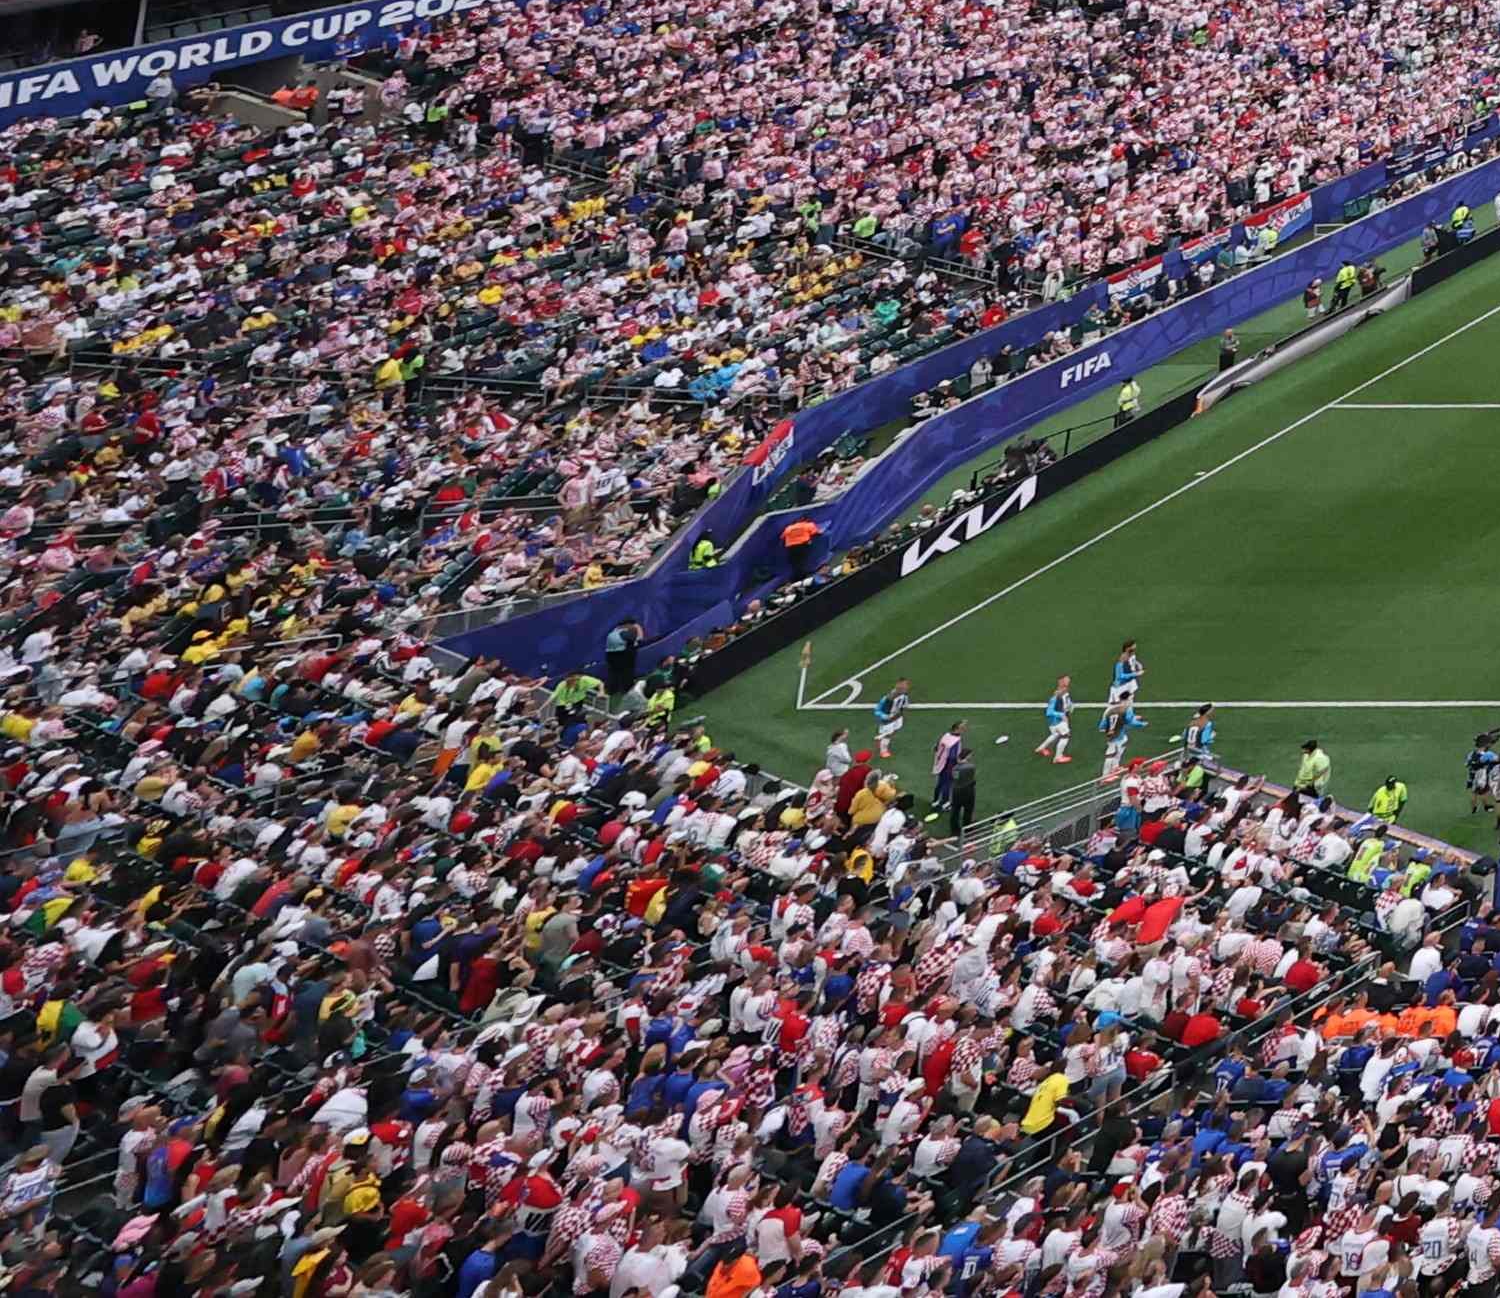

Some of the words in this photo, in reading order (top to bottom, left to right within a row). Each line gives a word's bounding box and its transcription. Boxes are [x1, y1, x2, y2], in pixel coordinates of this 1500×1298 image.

[91, 29, 275, 89] WORLD
[280, 6, 373, 48] CUP
[1060, 351, 1112, 389] FIFA
[1423, 1239, 1442, 1260] 20
